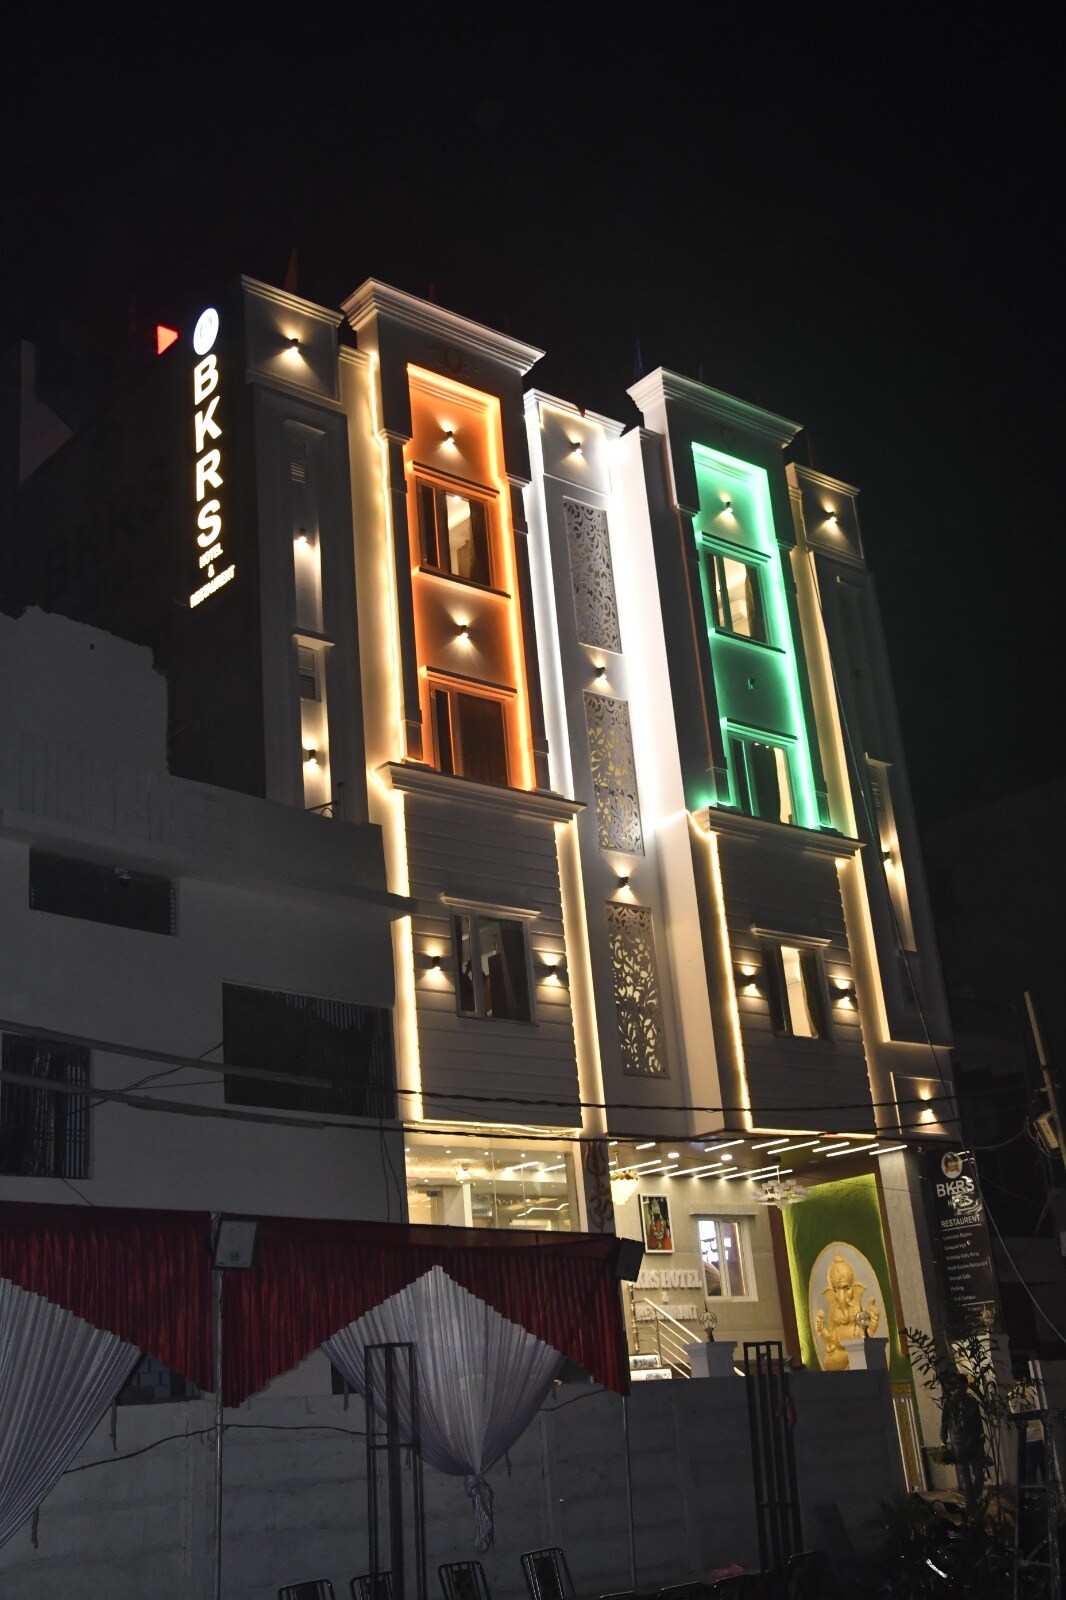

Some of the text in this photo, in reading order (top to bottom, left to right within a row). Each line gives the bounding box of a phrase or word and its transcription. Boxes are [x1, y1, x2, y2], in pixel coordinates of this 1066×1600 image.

[193, 353, 225, 548] BKRS
[936, 1179, 975, 1198] BKRS
[941, 1214, 981, 1229] RESTAURENT
[661, 1269, 703, 1288] HOTEL
